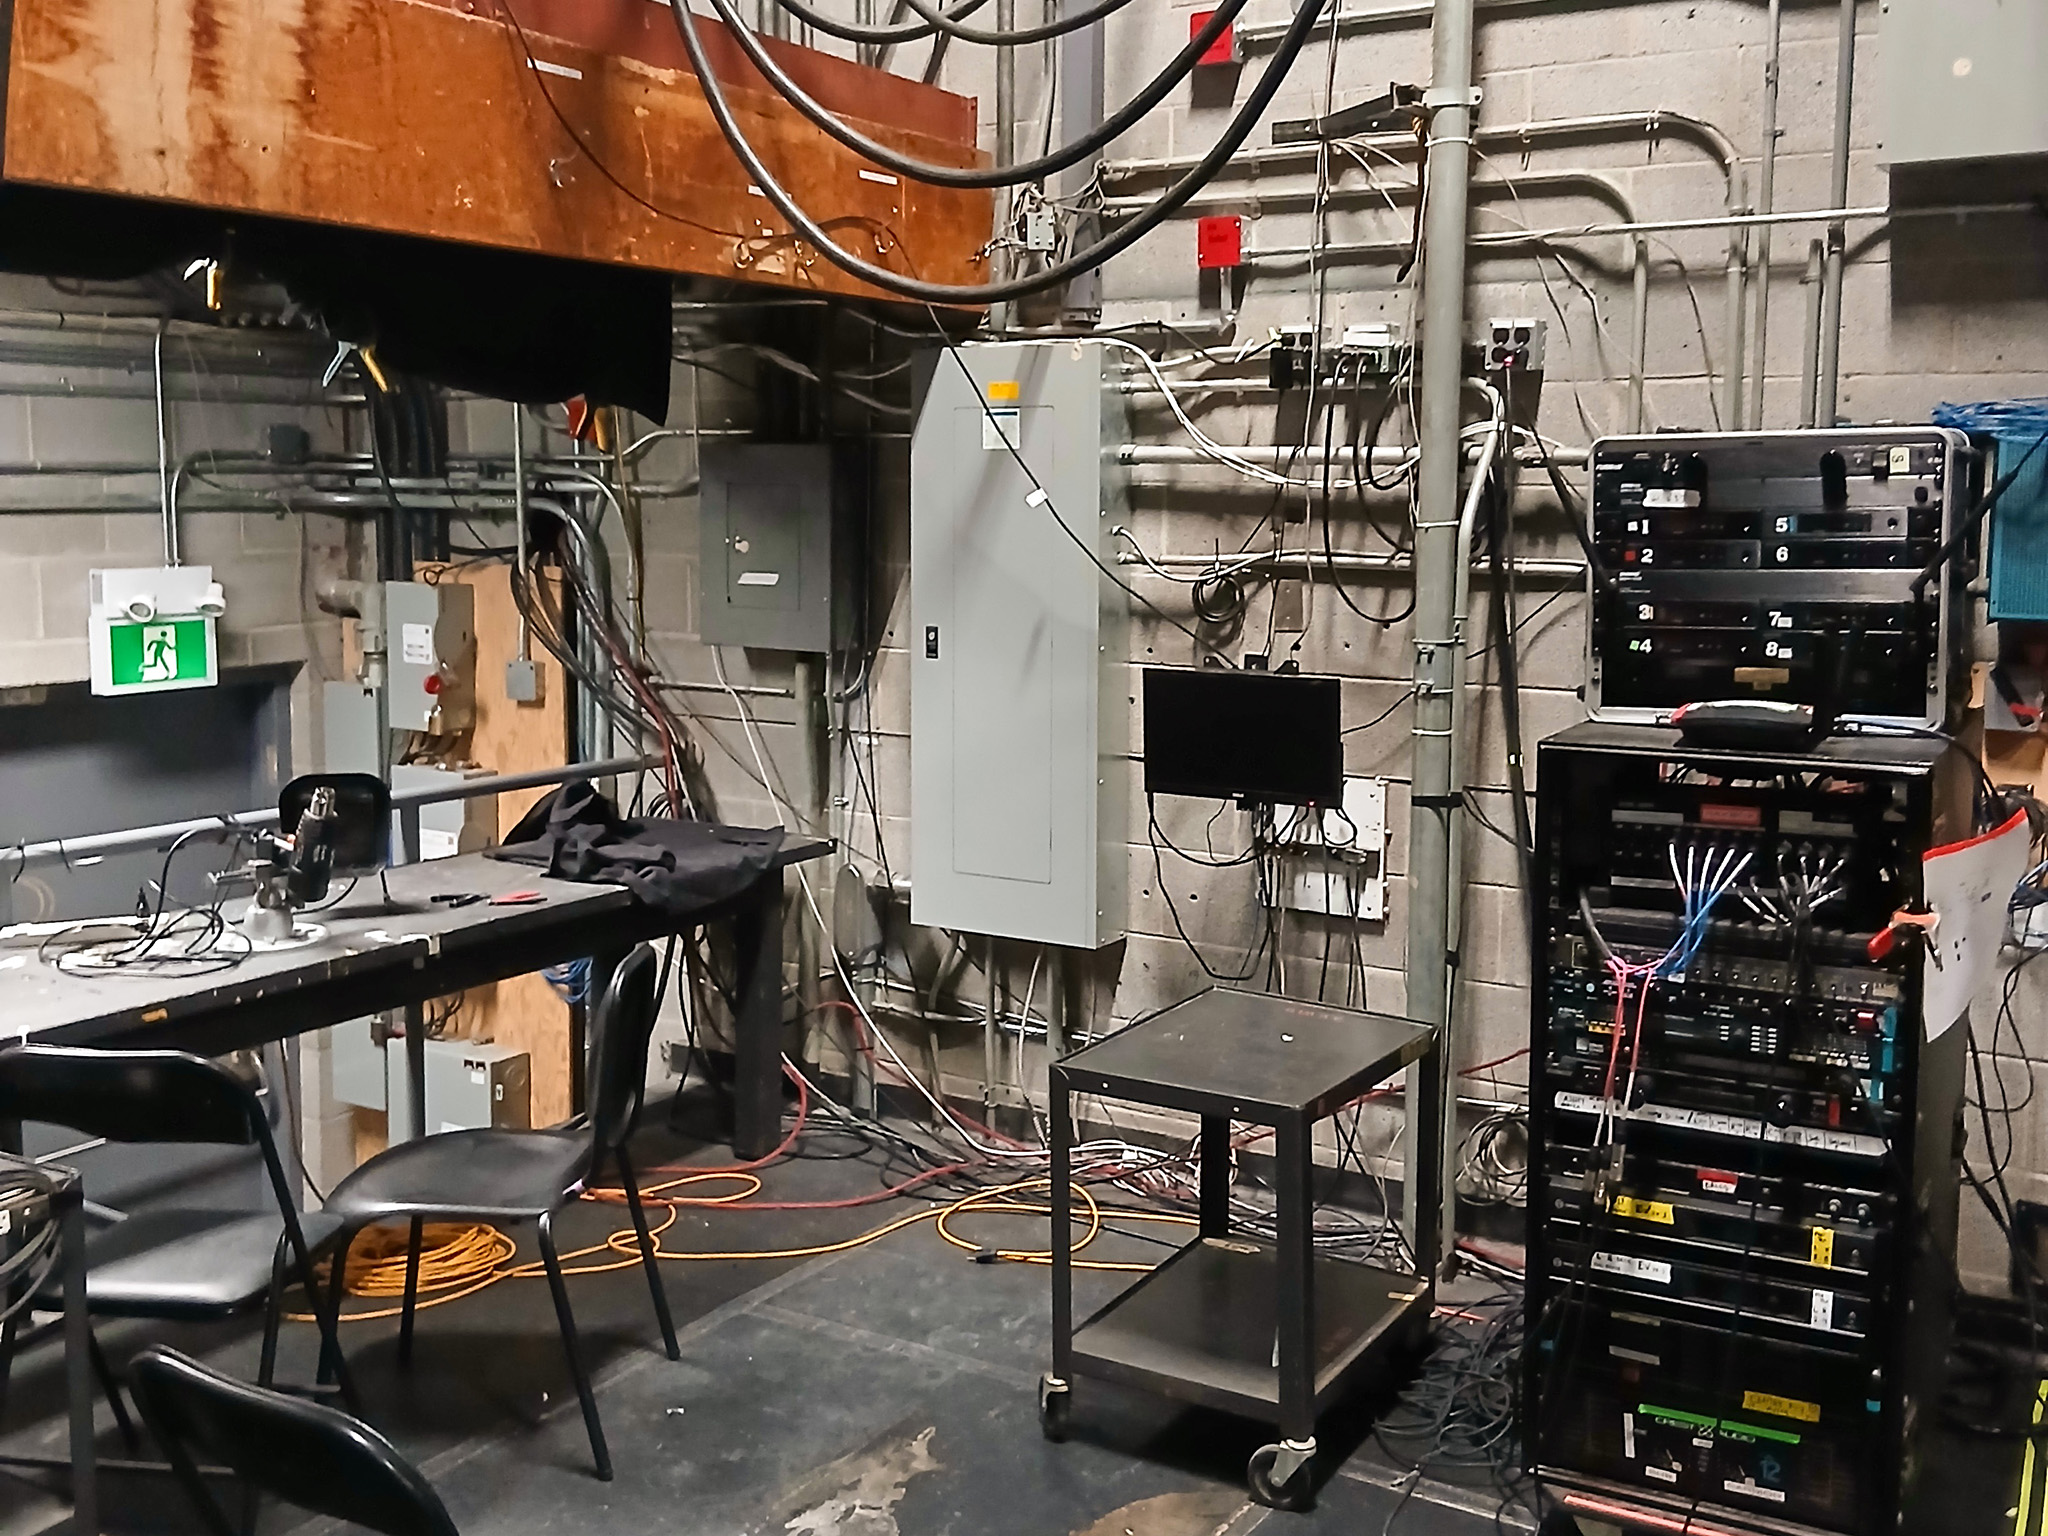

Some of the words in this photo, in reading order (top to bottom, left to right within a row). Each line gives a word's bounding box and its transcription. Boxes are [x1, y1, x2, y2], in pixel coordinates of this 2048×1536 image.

[1775, 516, 1788, 533] 5
[1640, 548, 1654, 564] 2
[1776, 546, 1789, 563] 6
[1638, 604, 1651, 620] 3
[1768, 611, 1782, 626] 7
[1639, 638, 1652, 654] 4
[1765, 641, 1779, 657] 8
